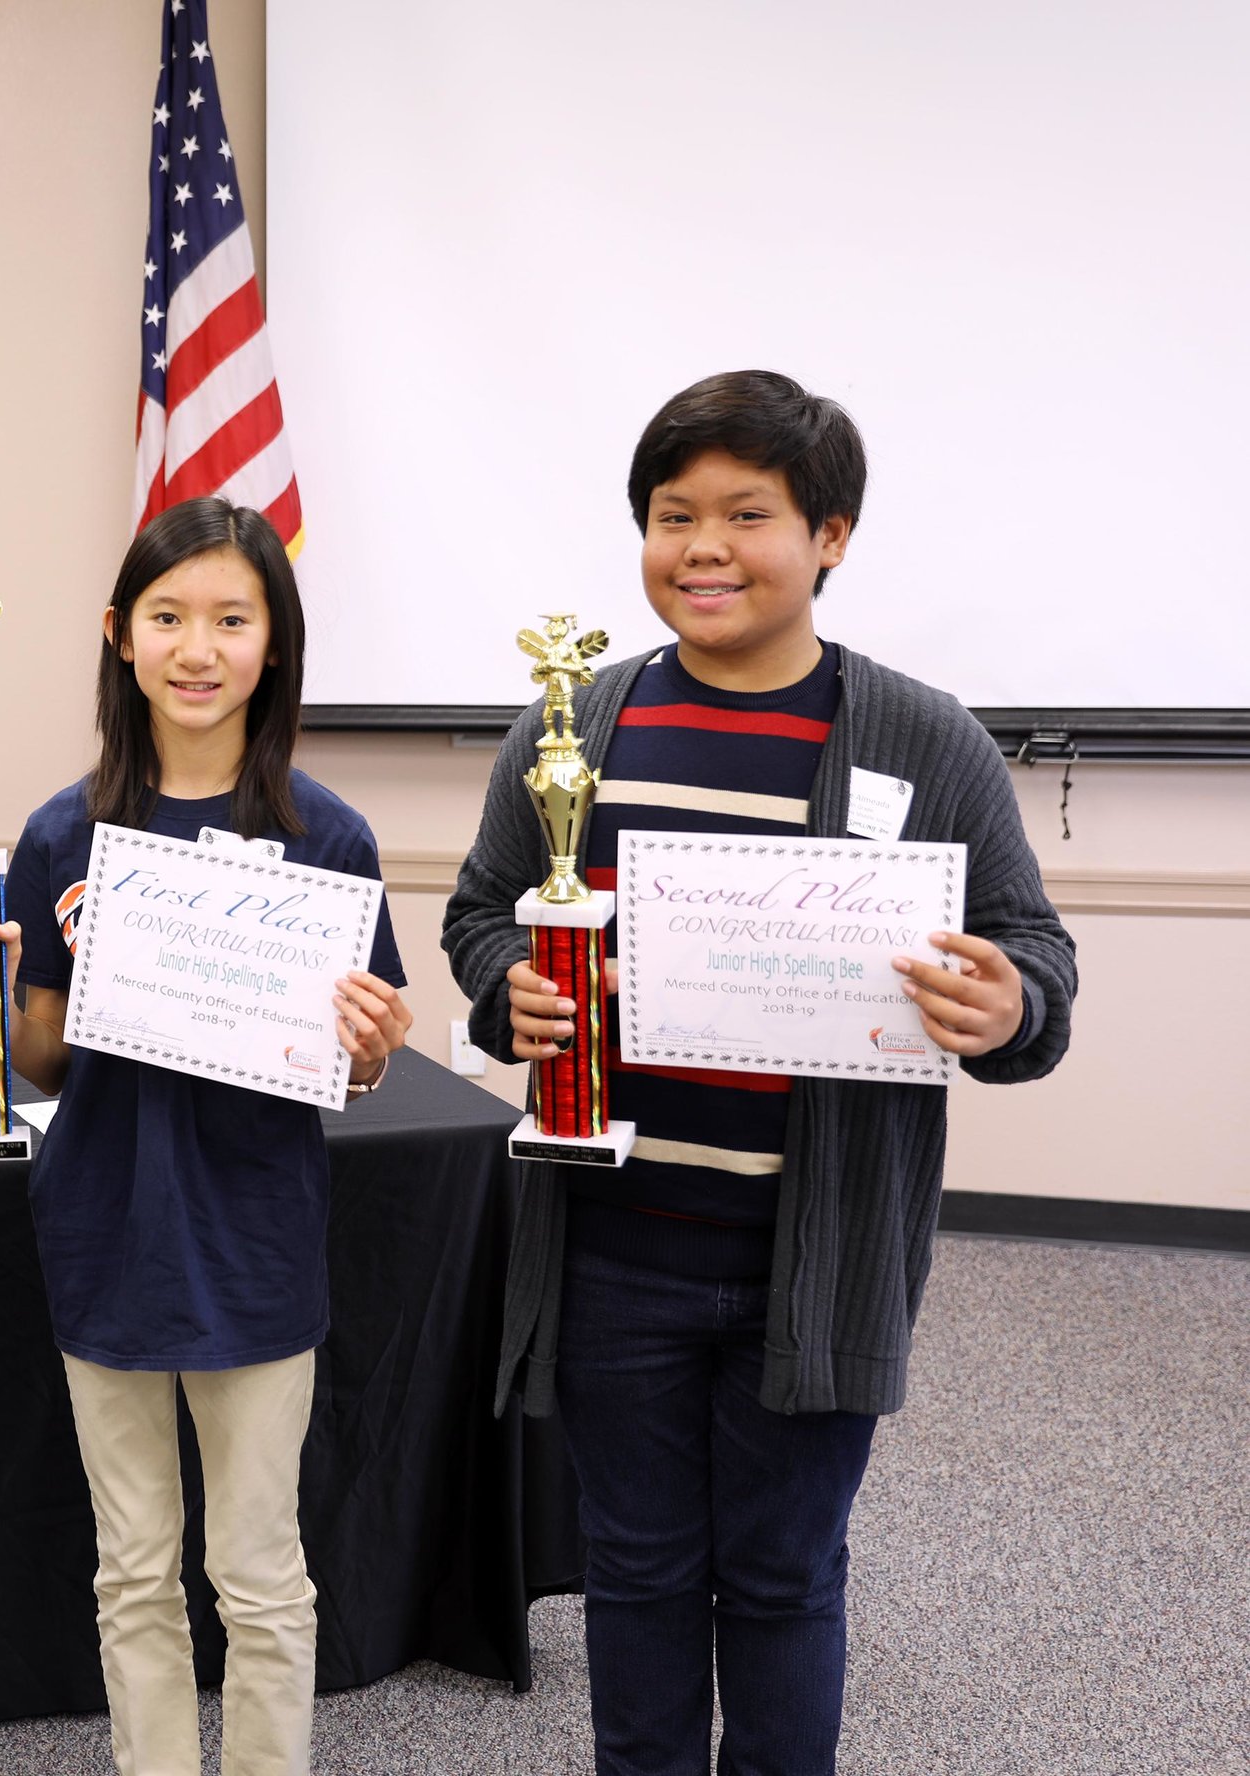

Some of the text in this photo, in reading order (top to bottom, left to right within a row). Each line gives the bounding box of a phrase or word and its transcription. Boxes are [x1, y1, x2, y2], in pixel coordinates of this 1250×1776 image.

[111, 868, 346, 940] First Place
[638, 867, 920, 915] Second Place
[123, 910, 329, 971] CONGRATULATIONS!
[668, 914, 918, 947] CONGRATULATIONS!
[155, 946, 287, 996] Junior High Spelling Bee
[706, 948, 863, 984] Junior High Spelling Bee
[112, 973, 323, 1033] Merced County Office of Education
[664, 978, 716, 993] Merced
[720, 981, 771, 997] County
[775, 984, 820, 1000] Office
[824, 987, 839, 1000] of
[190, 1011, 236, 1031] 2018-19
[761, 1003, 816, 1017] 2018-19
[881, 1034, 911, 1043] Office
[881, 1042, 926, 1050] Education
